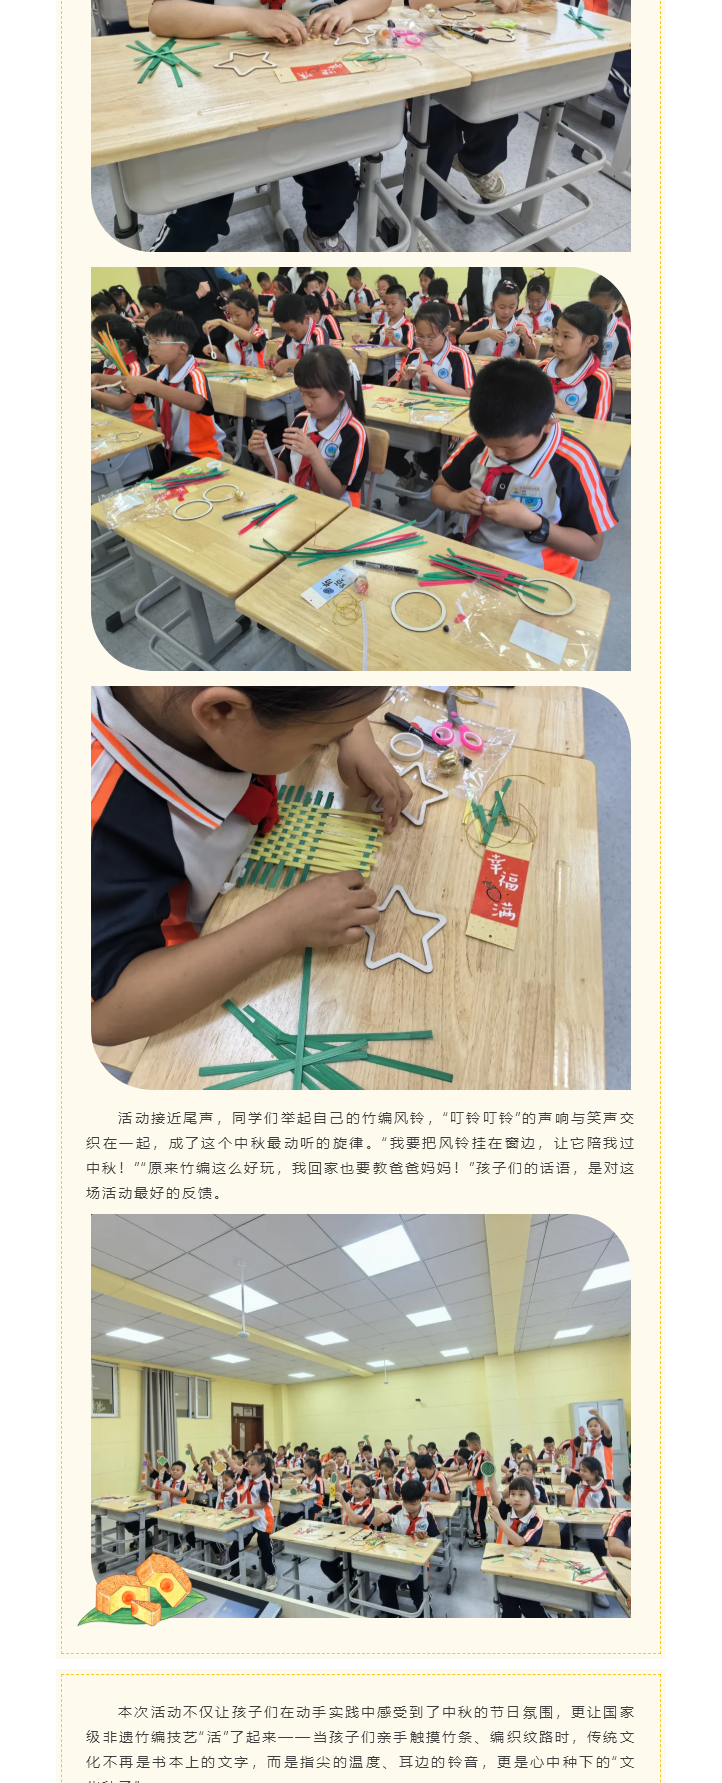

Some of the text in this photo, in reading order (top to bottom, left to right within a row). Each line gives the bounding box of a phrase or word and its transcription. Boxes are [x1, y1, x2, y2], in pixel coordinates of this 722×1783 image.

[86, 1186, 220, 1200] 场活动最好的反馈。
[117, 1705, 635, 1720] 本次活动不仅让孩子们在动手实践中感受到了中秋的节日氛围，更让国家
